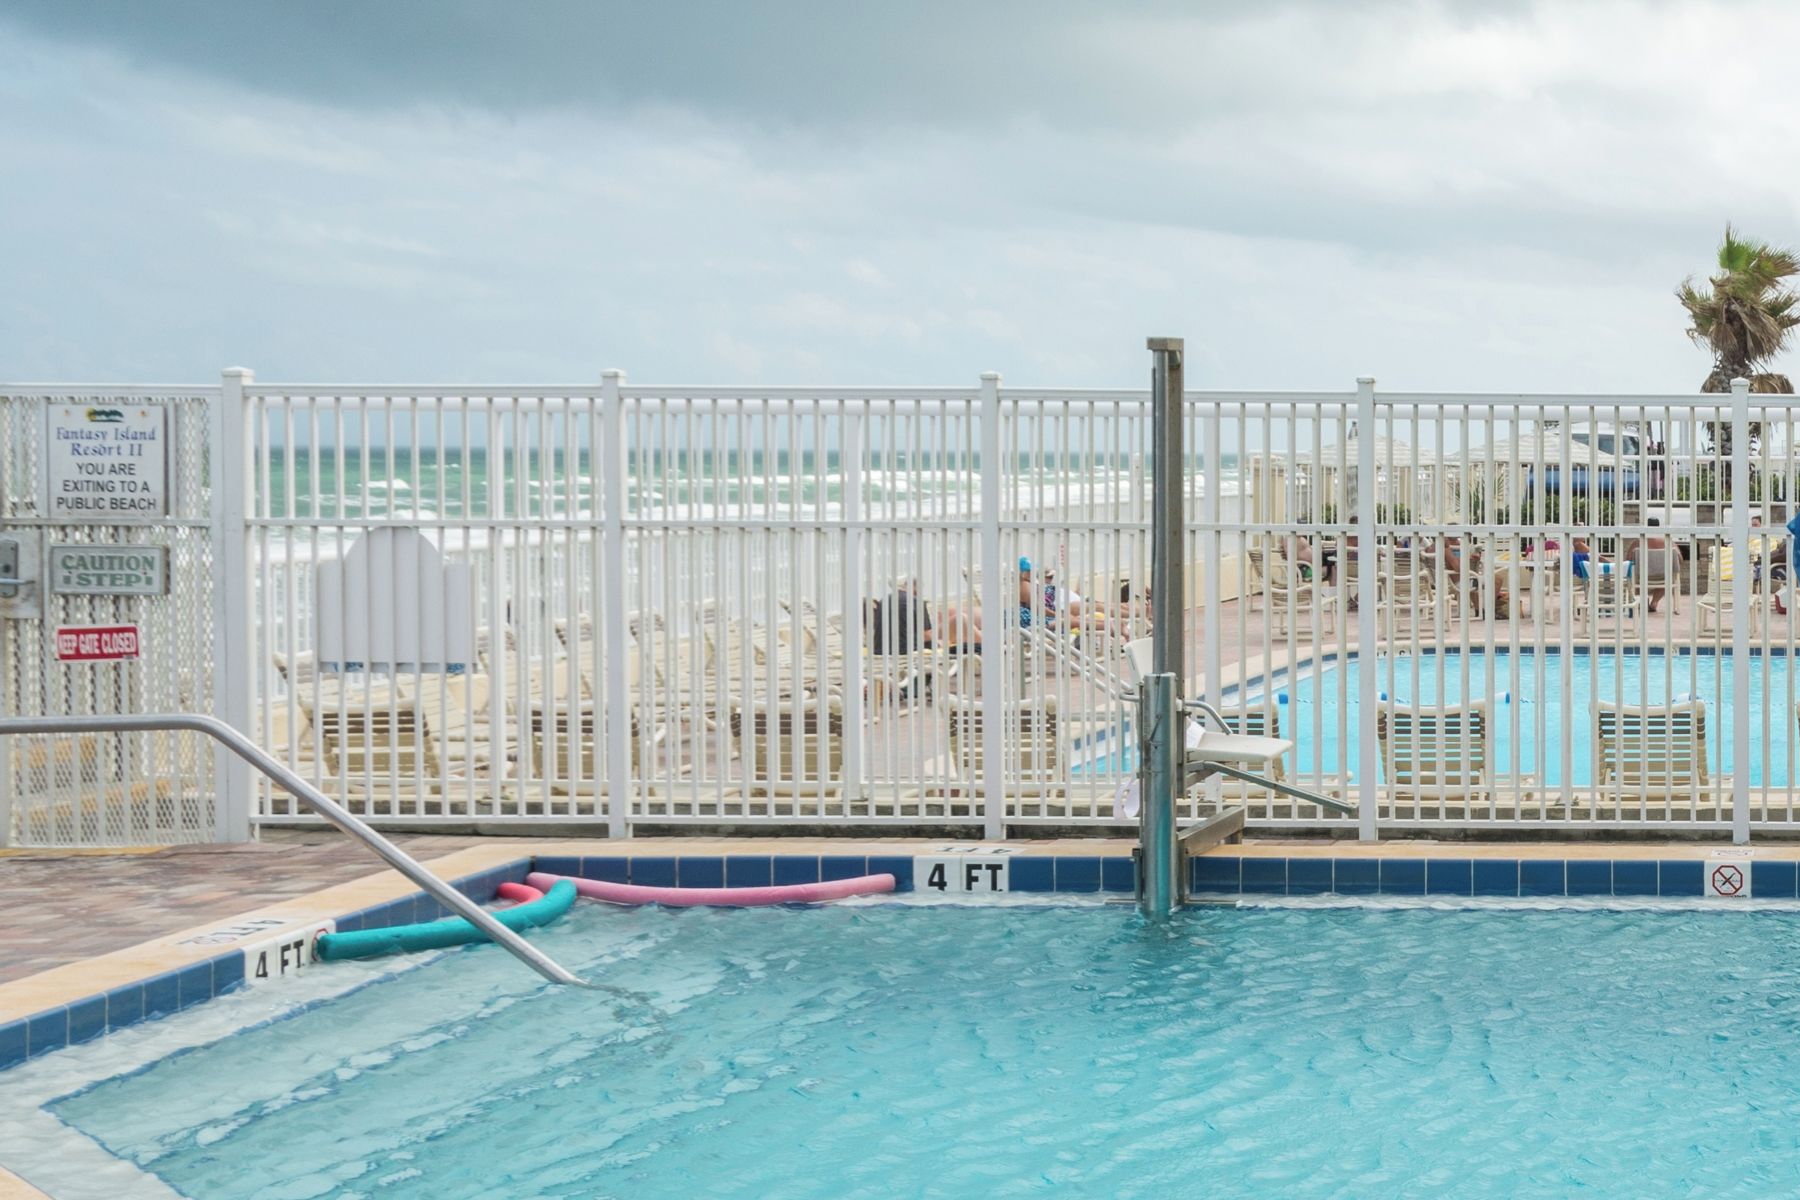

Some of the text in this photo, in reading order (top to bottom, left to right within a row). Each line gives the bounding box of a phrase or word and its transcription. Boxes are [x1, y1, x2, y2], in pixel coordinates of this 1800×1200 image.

[56, 426, 157, 441] Fantasy Island
[70, 443, 143, 456] Resort II
[76, 463, 136, 476] YOU ARE
[63, 480, 151, 493] EXITING TO A
[56, 497, 157, 511] PUBLIC BEACH
[60, 554, 155, 571] CAUTION
[76, 573, 142, 587] STEP
[79, 633, 101, 655] GATE
[101, 632, 137, 654] CLOSED
[928, 863, 947, 891] 4
[255, 950, 269, 978] 4
